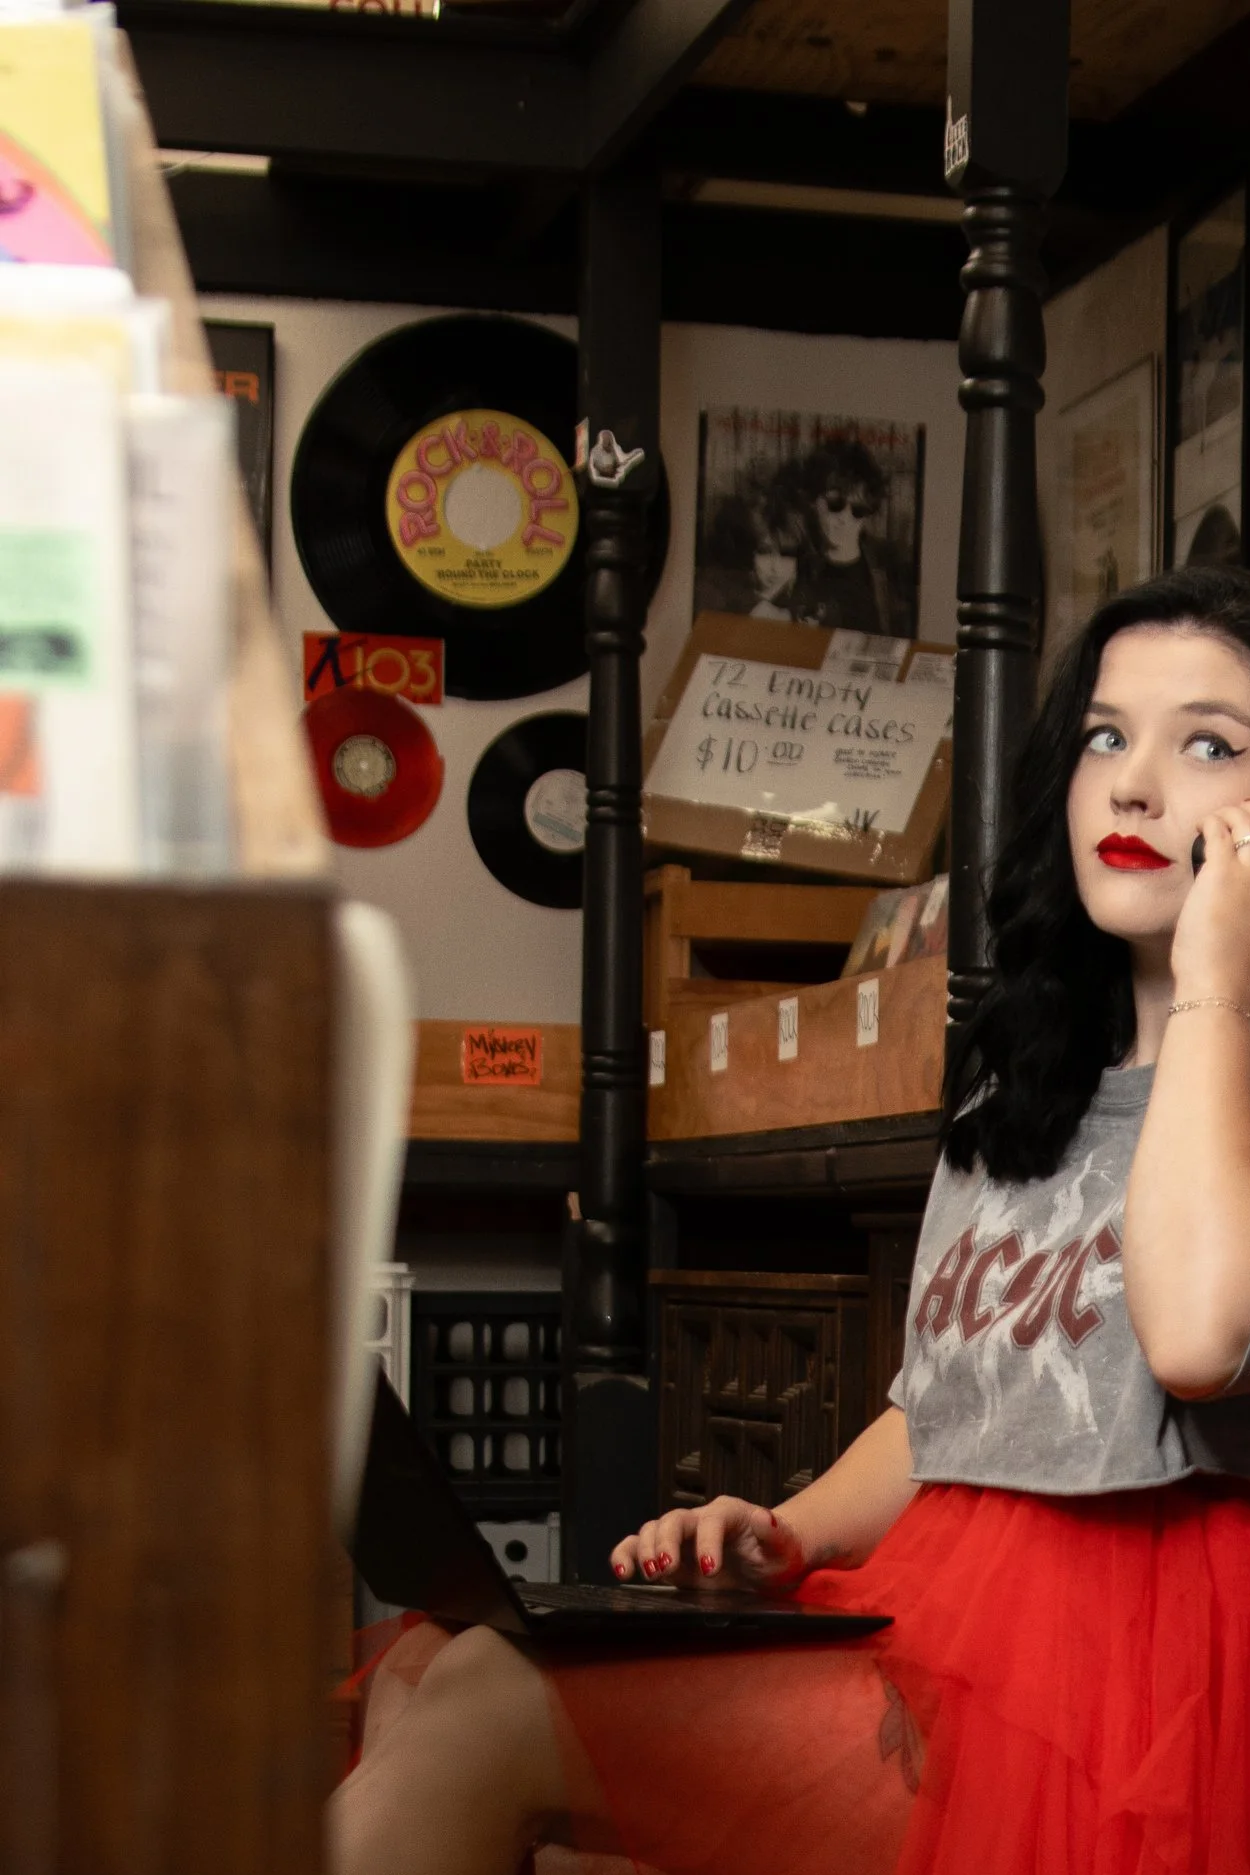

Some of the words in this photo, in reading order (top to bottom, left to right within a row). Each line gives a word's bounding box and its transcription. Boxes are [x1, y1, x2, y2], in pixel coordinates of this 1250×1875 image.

[501, 430, 569, 547] ROLL
[707, 660, 750, 688] 72
[767, 669, 873, 712] Empty
